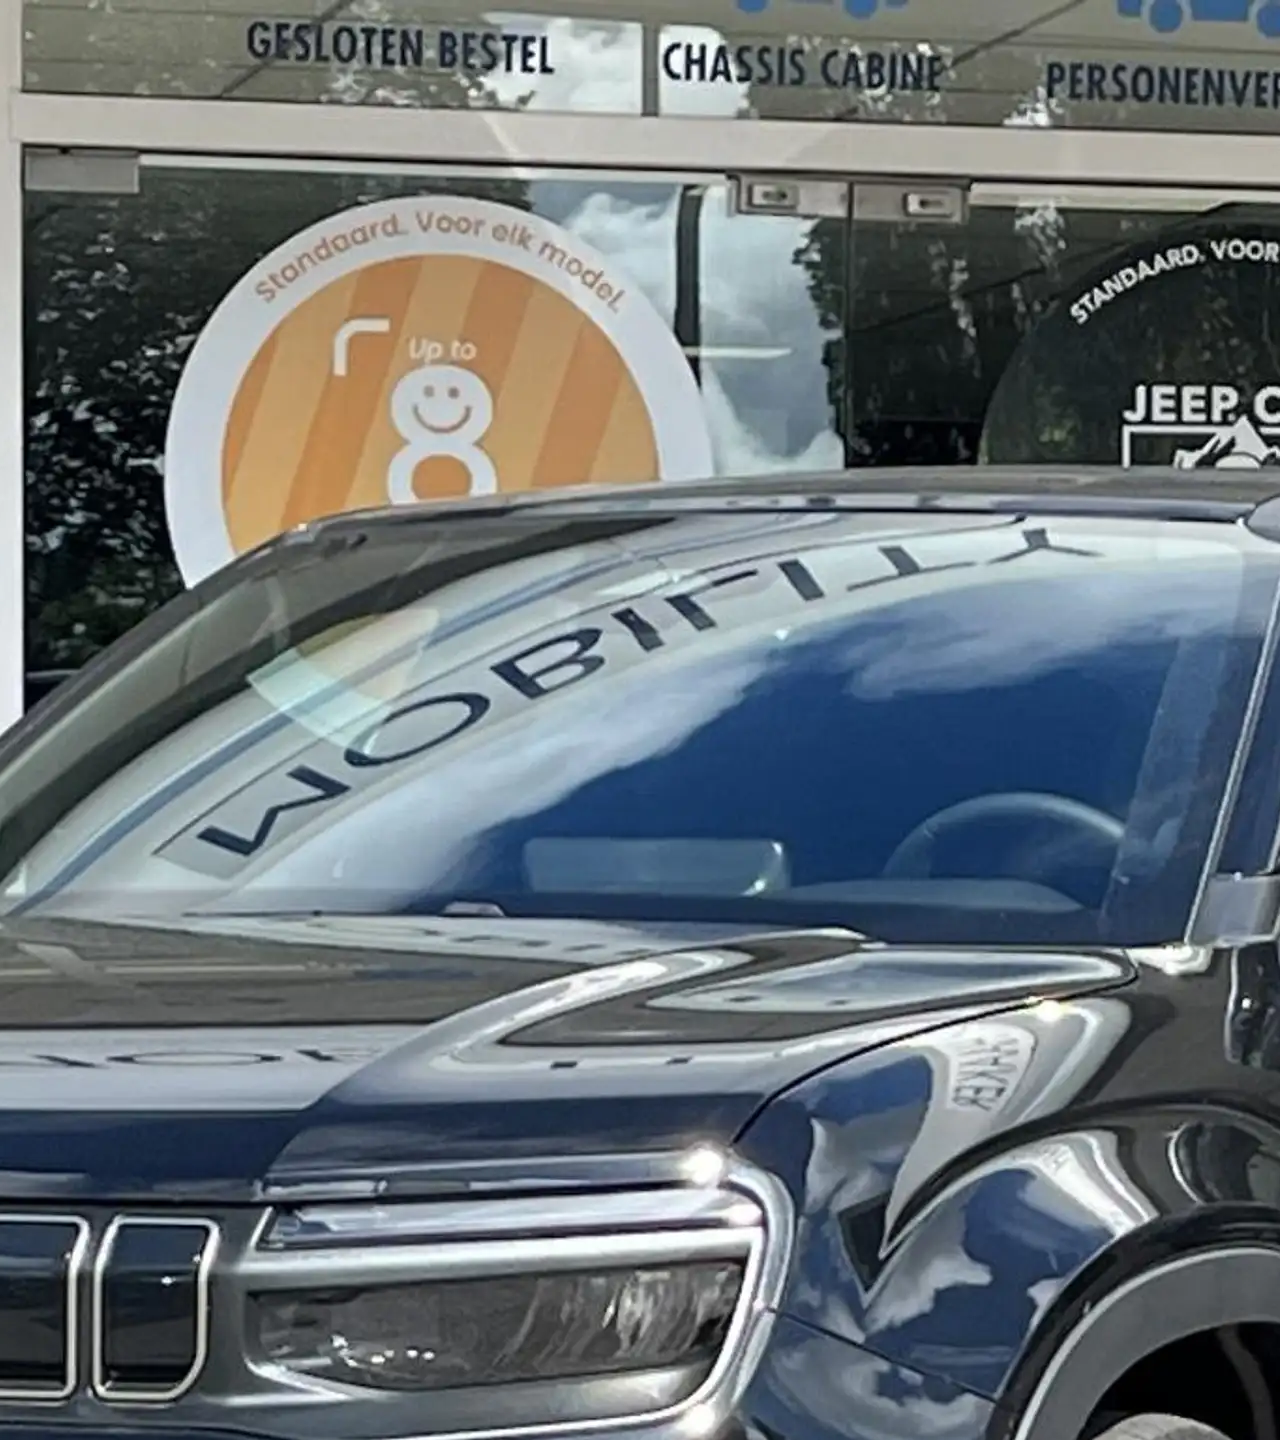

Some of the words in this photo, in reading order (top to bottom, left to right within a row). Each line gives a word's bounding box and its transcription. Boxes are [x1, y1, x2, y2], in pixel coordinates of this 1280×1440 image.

[246, 21, 423, 69] GESLOTEN
[438, 29, 555, 77] BESTEL
[662, 41, 808, 87] CHASSIS
[819, 50, 945, 94] CABINE
[254, 213, 408, 304] Standaard.
[415, 211, 483, 235] Voor
[491, 218, 535, 252] elk
[1210, 239, 1280, 262] VOOR
[408, 337, 442, 365] Up
[451, 337, 478, 361] to
